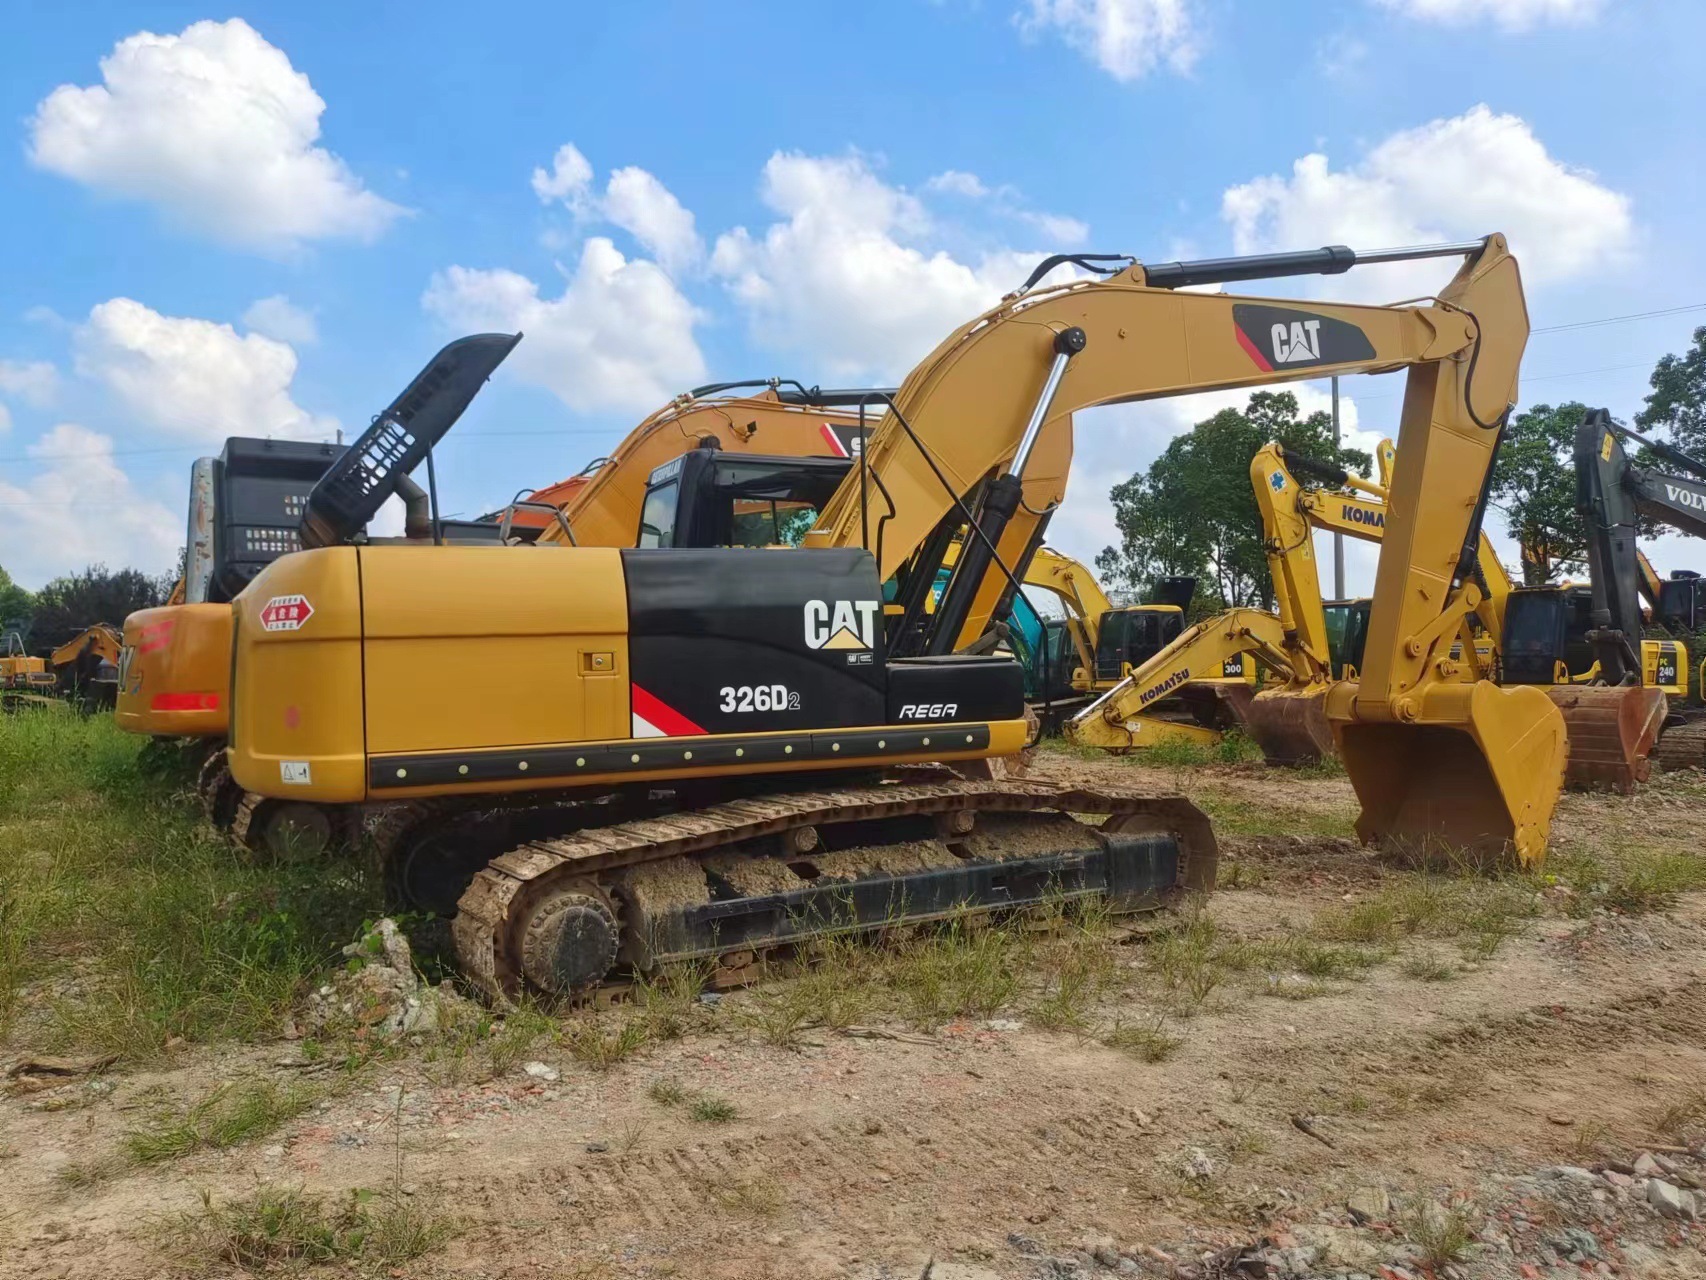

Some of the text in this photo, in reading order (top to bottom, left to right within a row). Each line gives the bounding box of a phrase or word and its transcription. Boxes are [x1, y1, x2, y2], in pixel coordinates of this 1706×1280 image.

[1270, 320, 1320, 363] CAT
[804, 599, 879, 650] CAT
[1225, 664, 1242, 674] 300
[1659, 658, 1668, 666] PC
[1659, 667, 1674, 677] 240
[1139, 668, 1191, 705] KOMATSU
[898, 703, 958, 719] REGA
